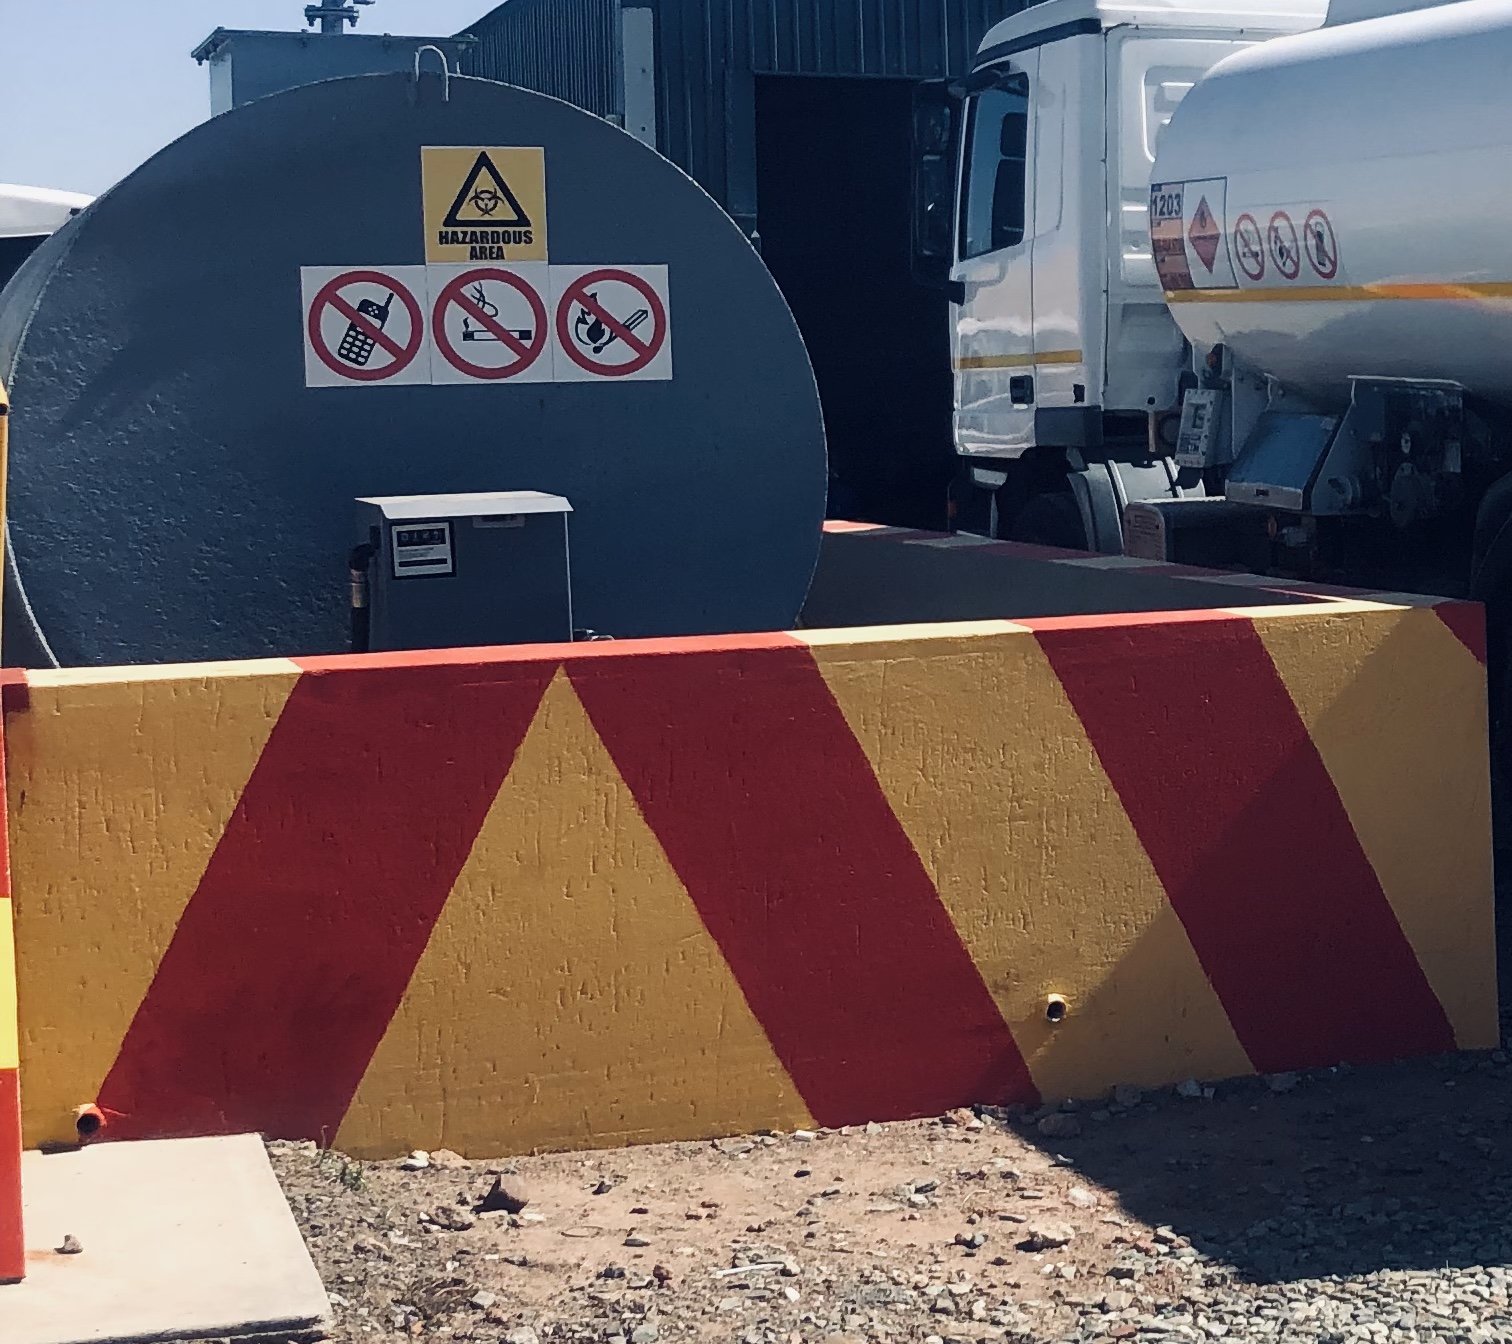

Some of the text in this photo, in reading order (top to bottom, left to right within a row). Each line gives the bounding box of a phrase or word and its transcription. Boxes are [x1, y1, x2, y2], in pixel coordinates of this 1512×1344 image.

[1152, 194, 1181, 217] 1203
[438, 230, 533, 245] HAZARDOUS
[469, 246, 505, 260] AREA
